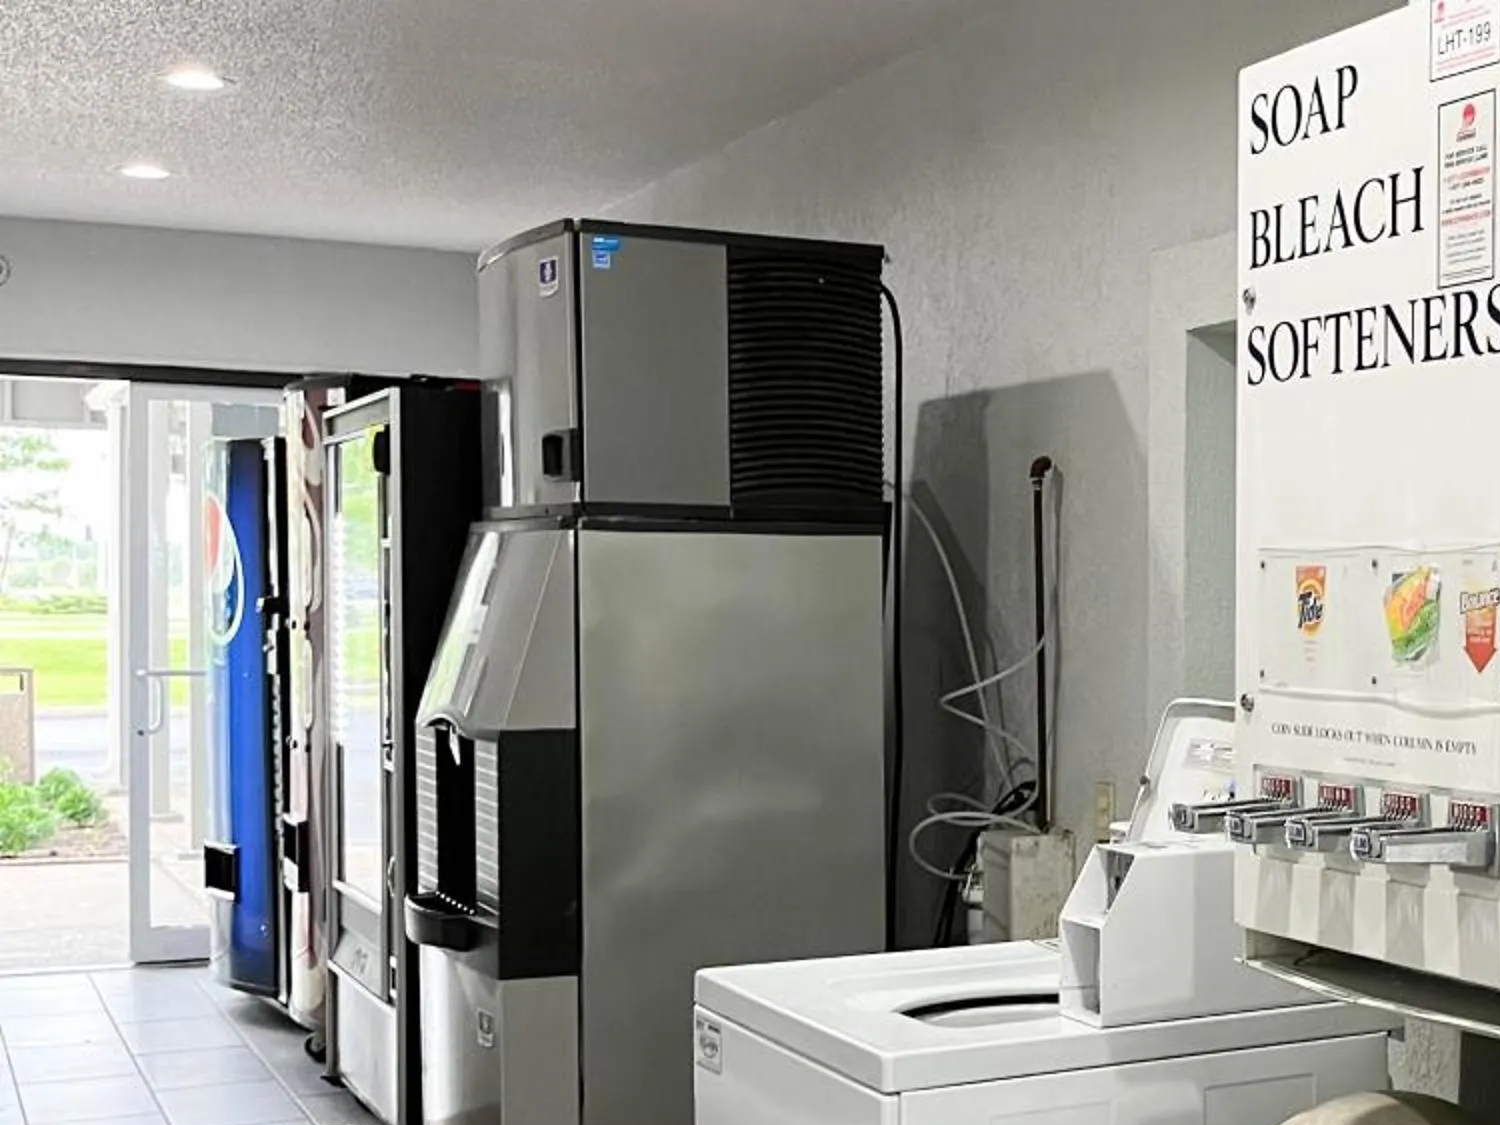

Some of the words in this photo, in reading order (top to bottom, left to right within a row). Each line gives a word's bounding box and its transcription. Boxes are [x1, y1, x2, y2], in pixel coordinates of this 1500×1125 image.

[1437, 20, 1492, 56] LHT-199
[1250, 64, 1359, 155] SOAP
[1249, 165, 1425, 270] BLEACH
[1343, 729, 1362, 744] OUT
